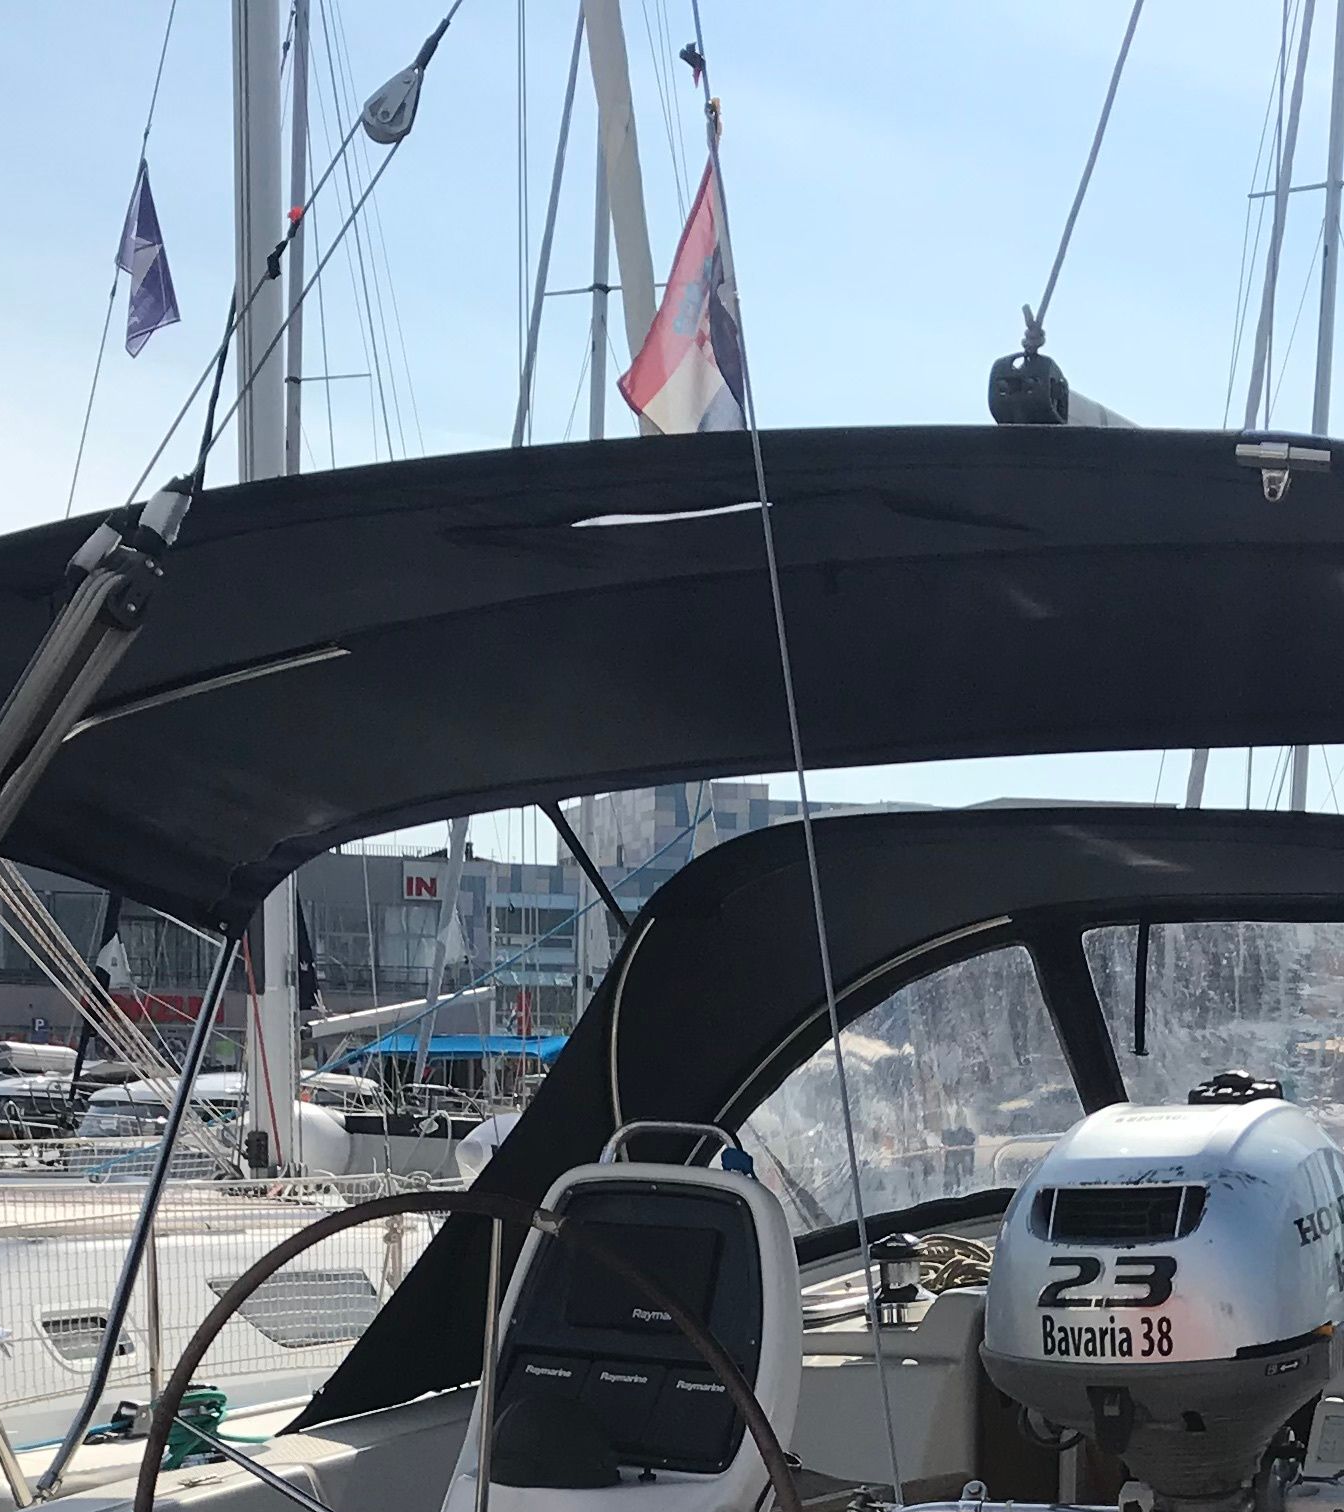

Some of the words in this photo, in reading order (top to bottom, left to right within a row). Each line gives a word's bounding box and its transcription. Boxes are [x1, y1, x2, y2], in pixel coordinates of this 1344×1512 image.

[406, 876, 437, 897] IN
[35, 1018, 45, 1031] P
[632, 1308, 672, 1322] Rayma
[1042, 1315, 1134, 1358] Bavaria
[1141, 1316, 1174, 1357] 38
[525, 1364, 573, 1378] Raymarine
[600, 1371, 648, 1384] Raymarine
[676, 1380, 726, 1393] Raymarine
